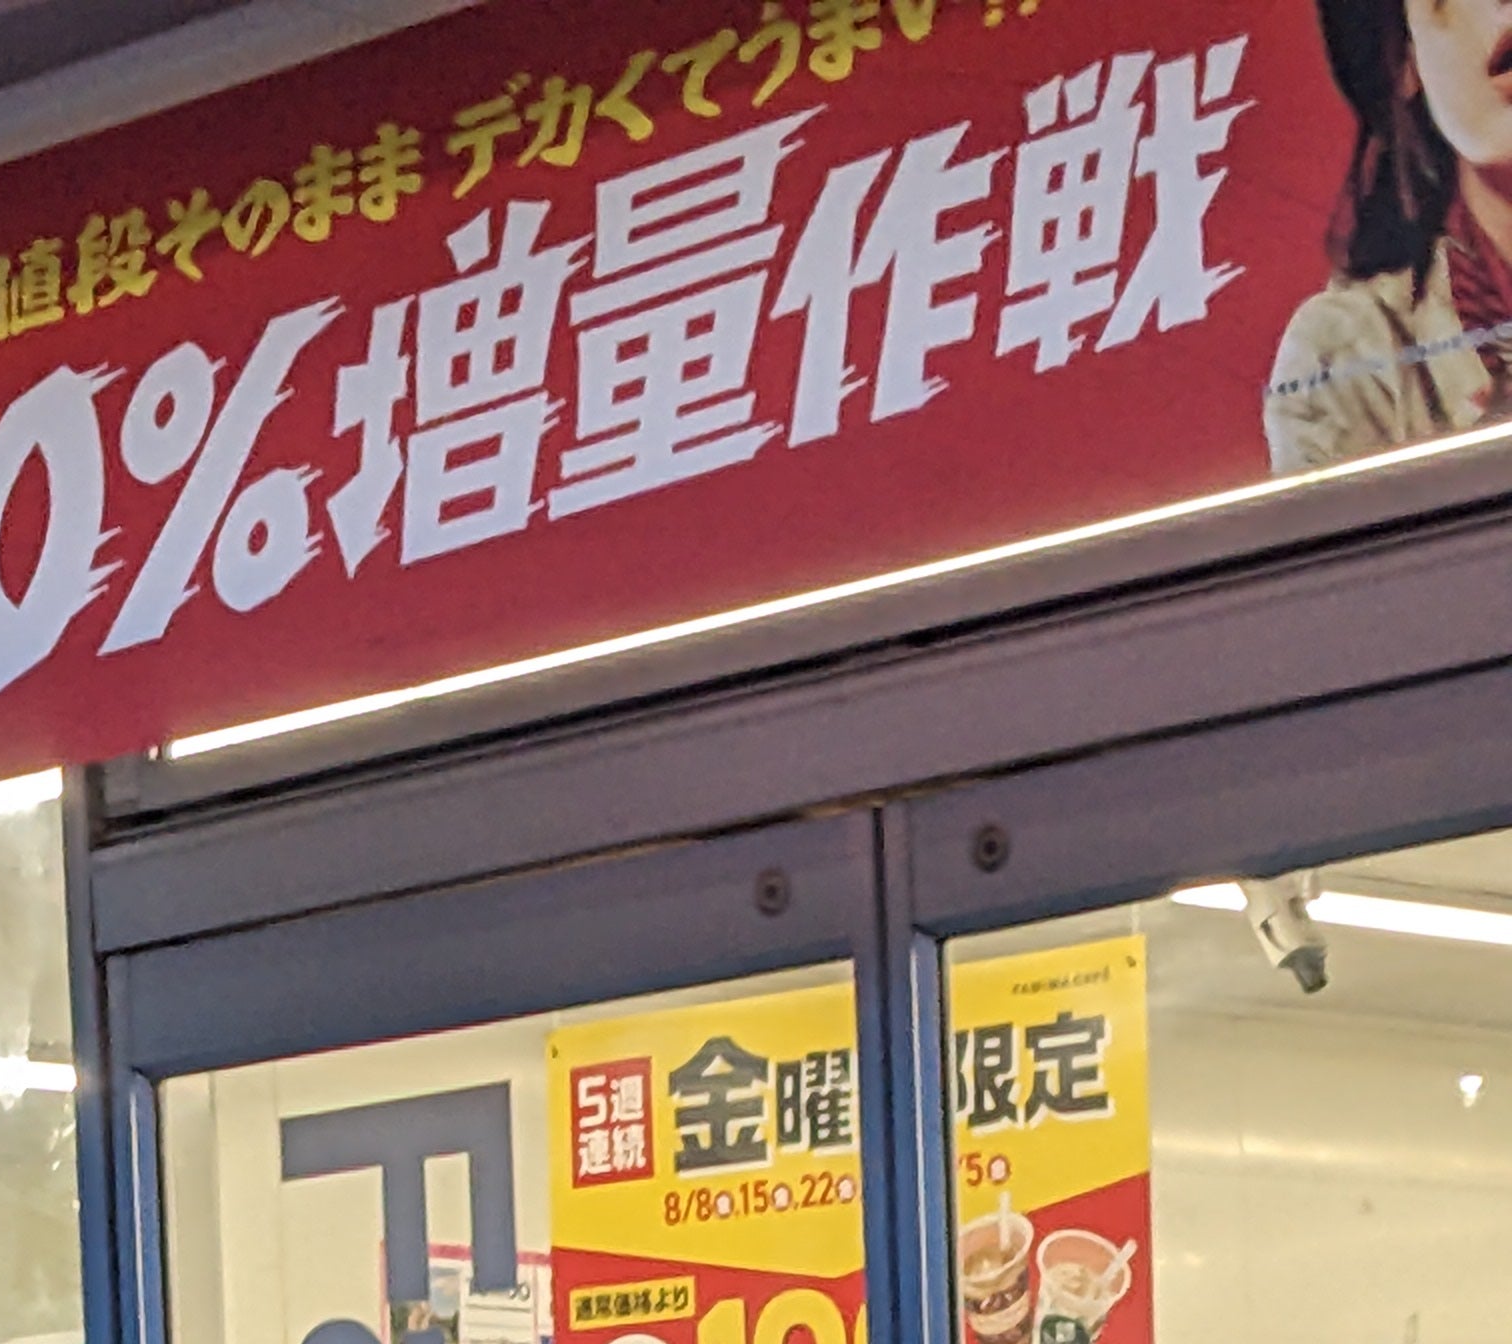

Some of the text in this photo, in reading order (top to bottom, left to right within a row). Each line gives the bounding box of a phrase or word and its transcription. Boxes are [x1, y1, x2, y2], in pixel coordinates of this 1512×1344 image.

[448, 0, 1039, 198] デカくてうま
[667, 1010, 1110, 1170] 金曜 限定
